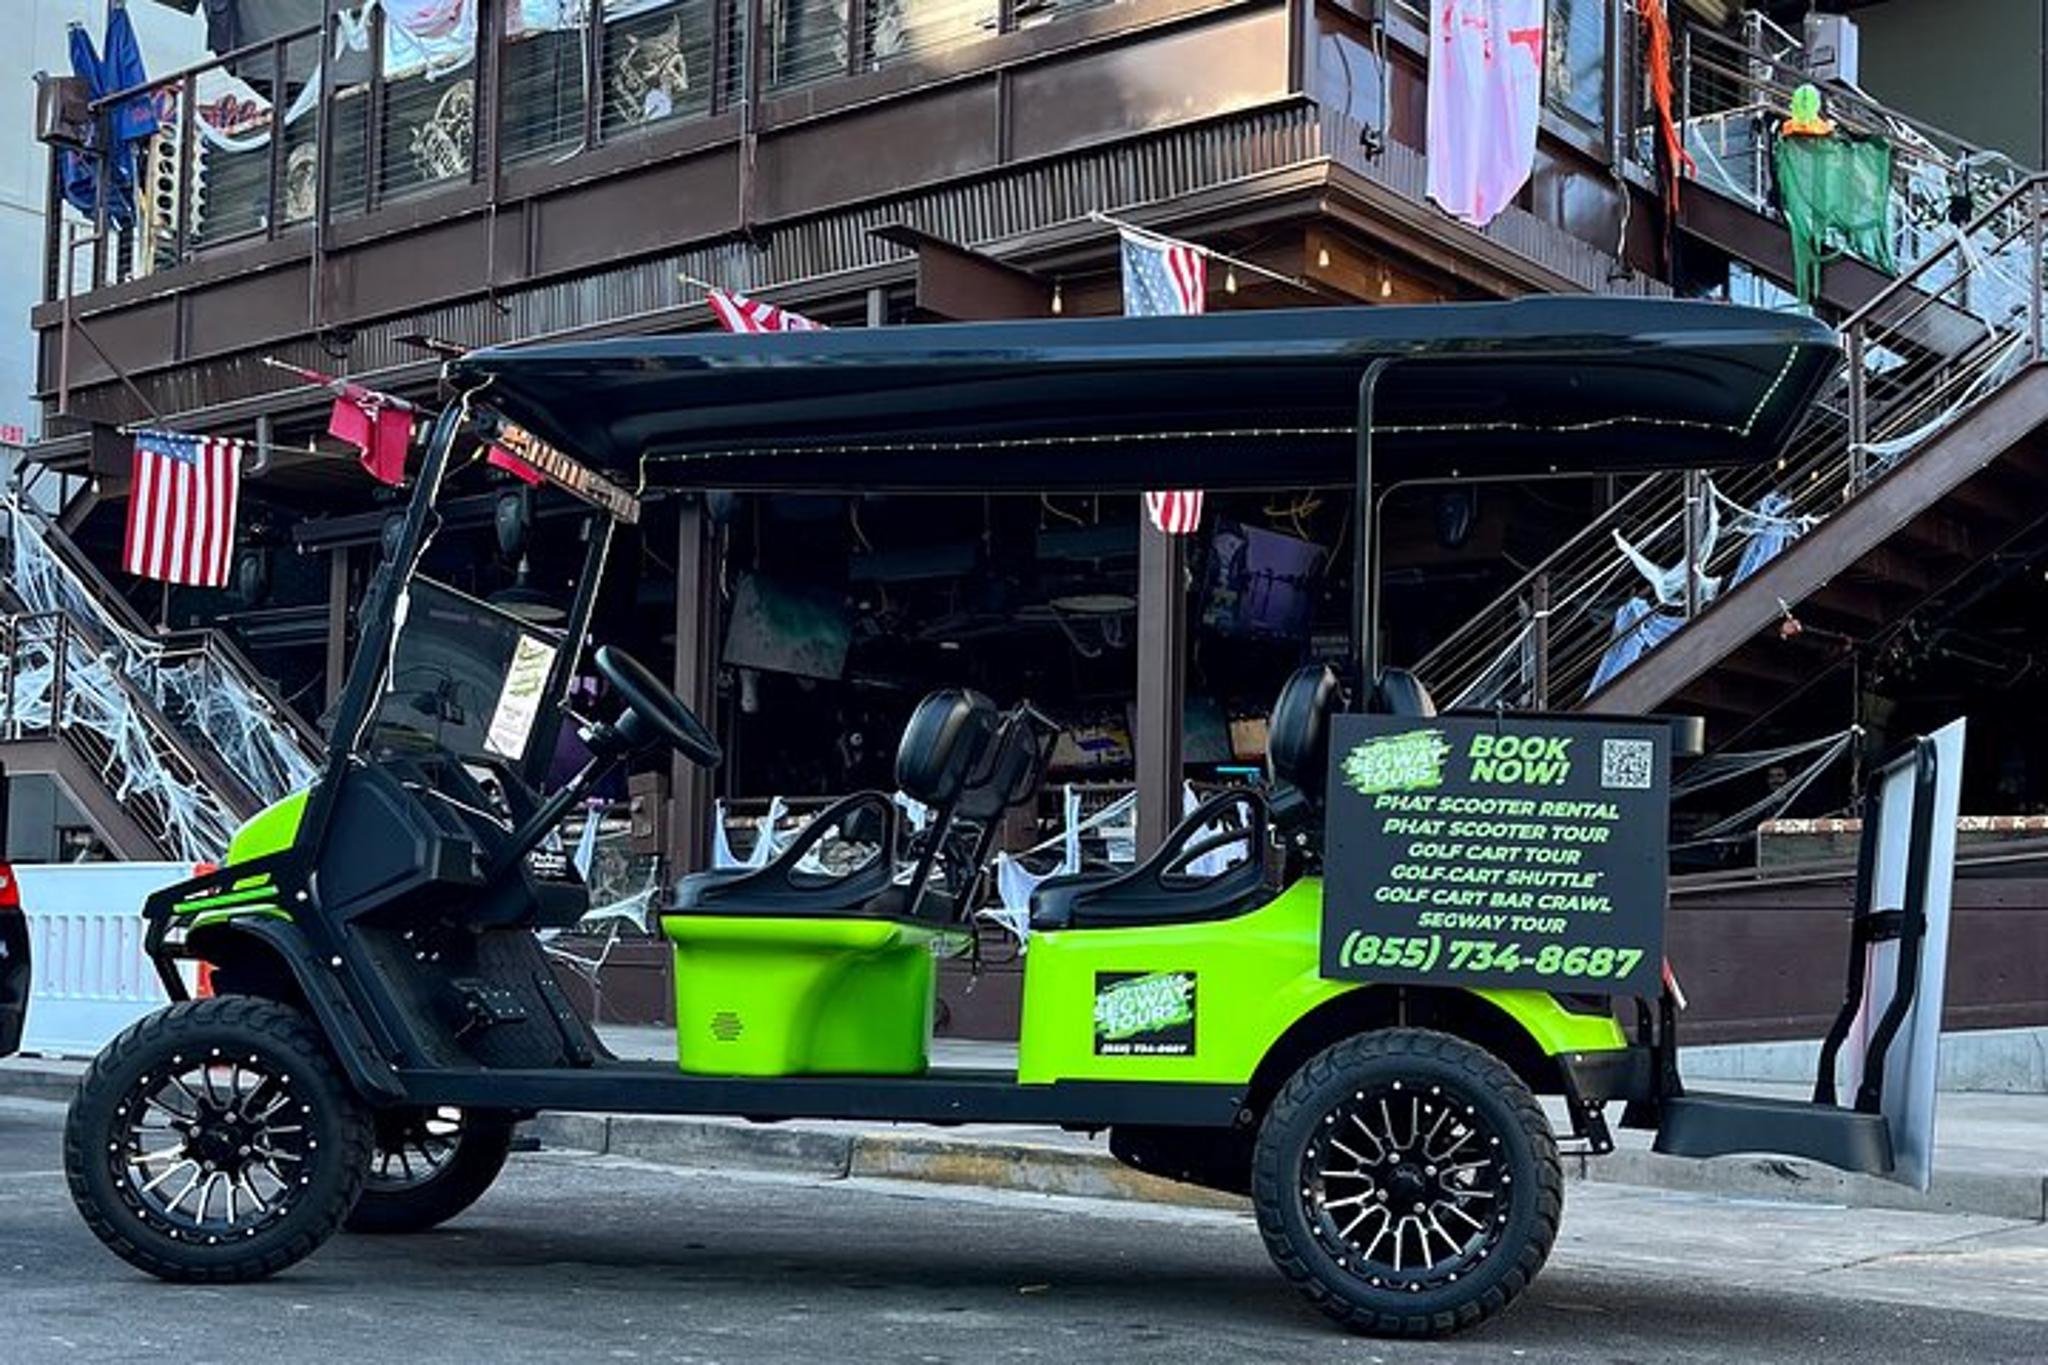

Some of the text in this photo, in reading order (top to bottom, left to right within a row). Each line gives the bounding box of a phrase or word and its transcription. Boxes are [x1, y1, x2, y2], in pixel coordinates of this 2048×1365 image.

[1468, 734, 1573, 760] BOOK
[1362, 764, 1432, 788] TOURS
[1469, 759, 1571, 785] NOW!
[1374, 795, 1619, 819] PHAT SCOOTER RENTAL
[1382, 818, 1609, 842] PHAT SCOOTER TOUR
[1408, 842, 1581, 864] GOLF CART TOUR
[1390, 864, 1446, 880] GOLF
[1449, 867, 1504, 883] CART
[1374, 886, 1613, 912] GOLF CART BAR CRAWL
[1418, 912, 1567, 933] SEGWAY TOUR
[1339, 930, 1643, 978] (855) 734-8687
[1093, 983, 1187, 1022] SEGWAY
